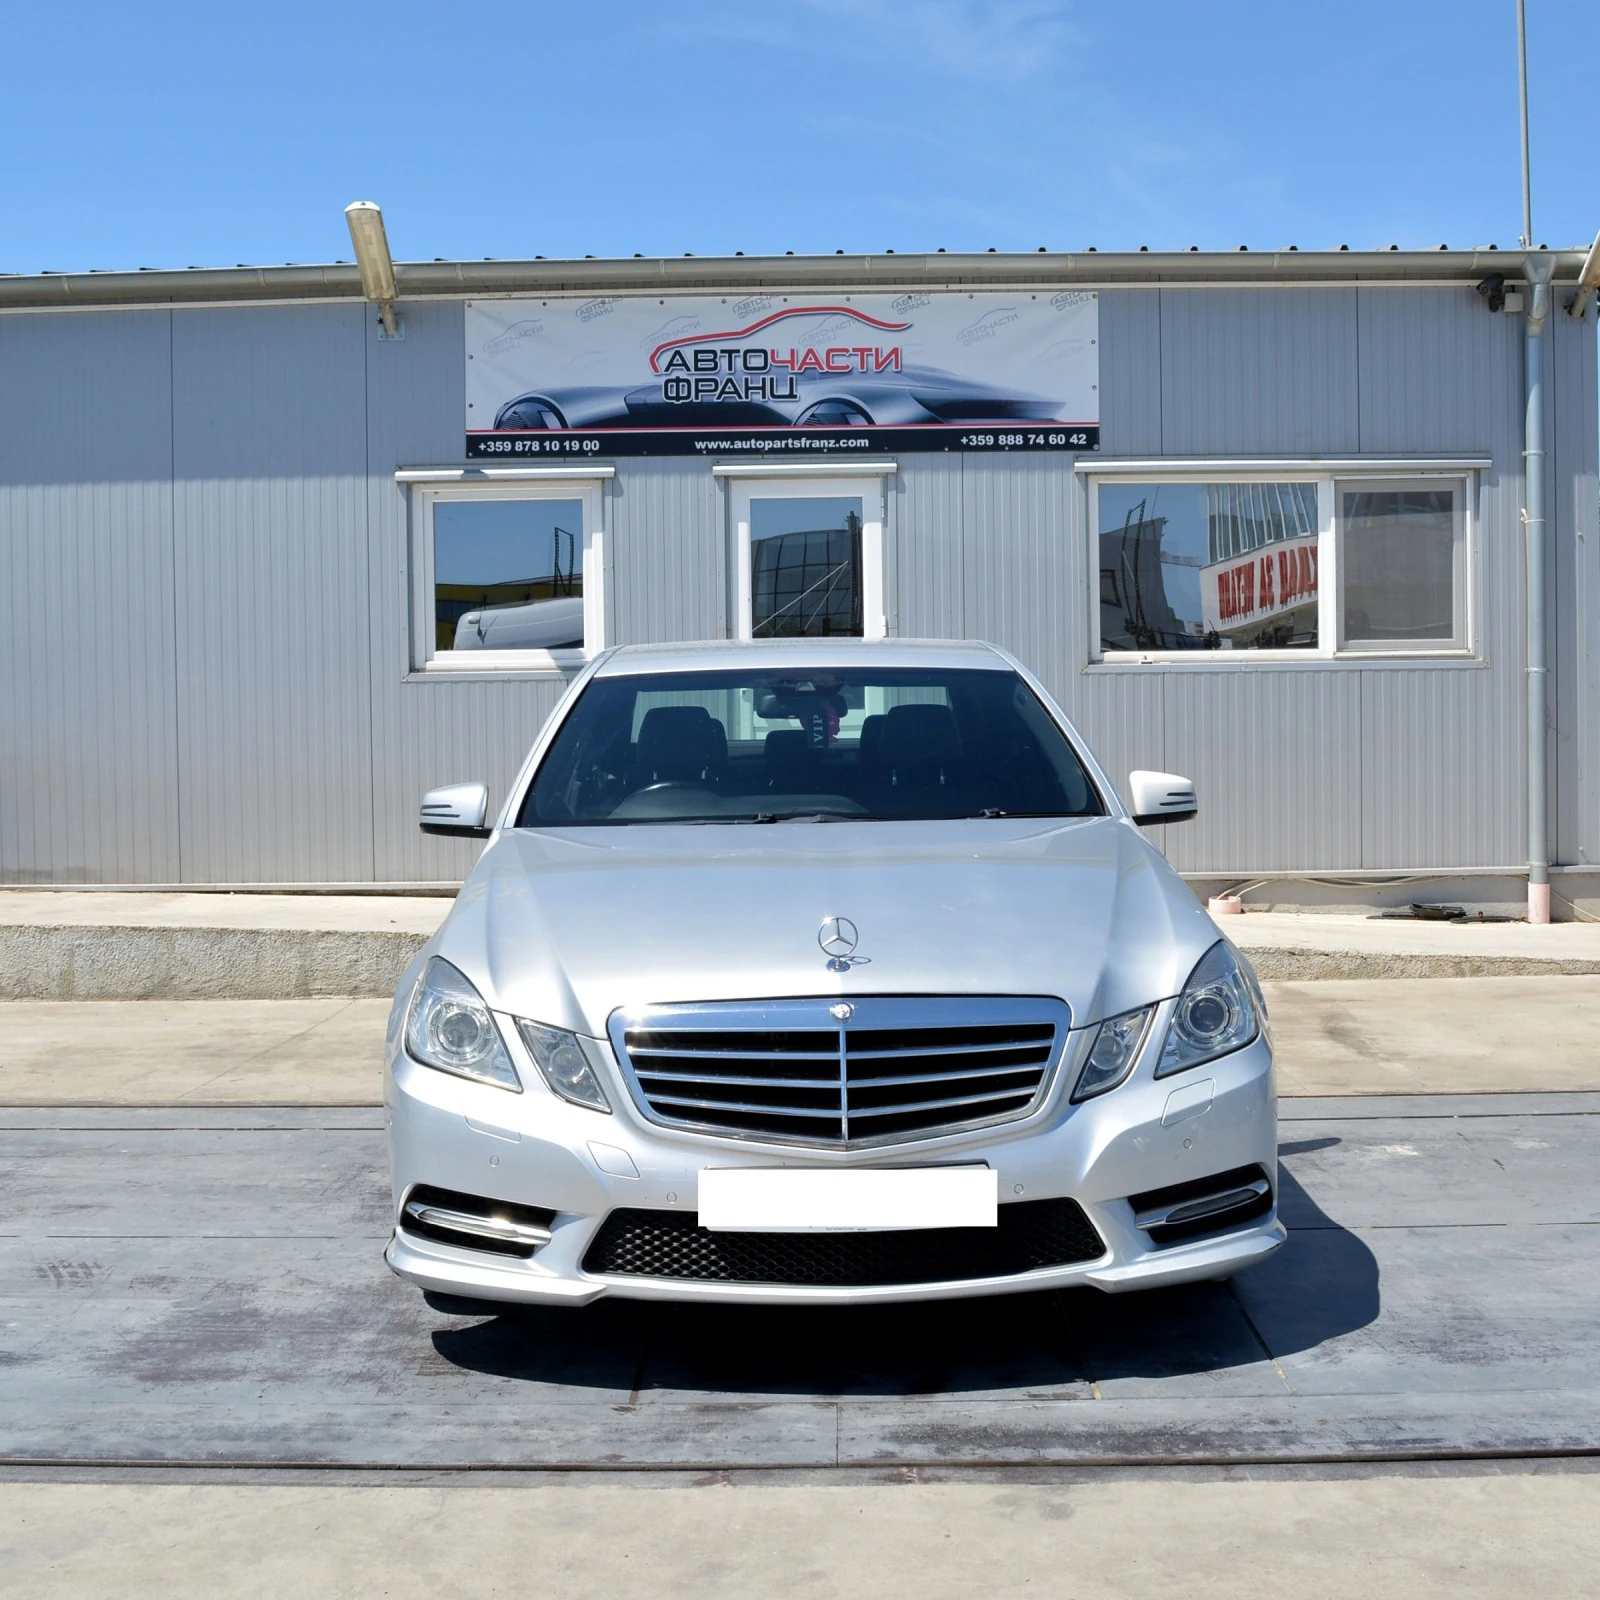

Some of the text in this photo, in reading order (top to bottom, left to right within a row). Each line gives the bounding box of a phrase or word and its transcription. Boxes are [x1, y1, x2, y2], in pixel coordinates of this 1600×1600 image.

[486, 325, 544, 351] АВТОЧАСТИ
[960, 313, 1018, 340] АВТОЧАСТИ
[663, 346, 902, 373] АВТОЧАСТИ
[663, 375, 799, 403] ФРАНЦ
[478, 440, 600, 452] +359 878 10 19 00
[694, 437, 870, 450] www.autopartsfranz.com
[960, 434, 1087, 446] +359 888 74 60 42
[812, 714, 824, 743] VIP
